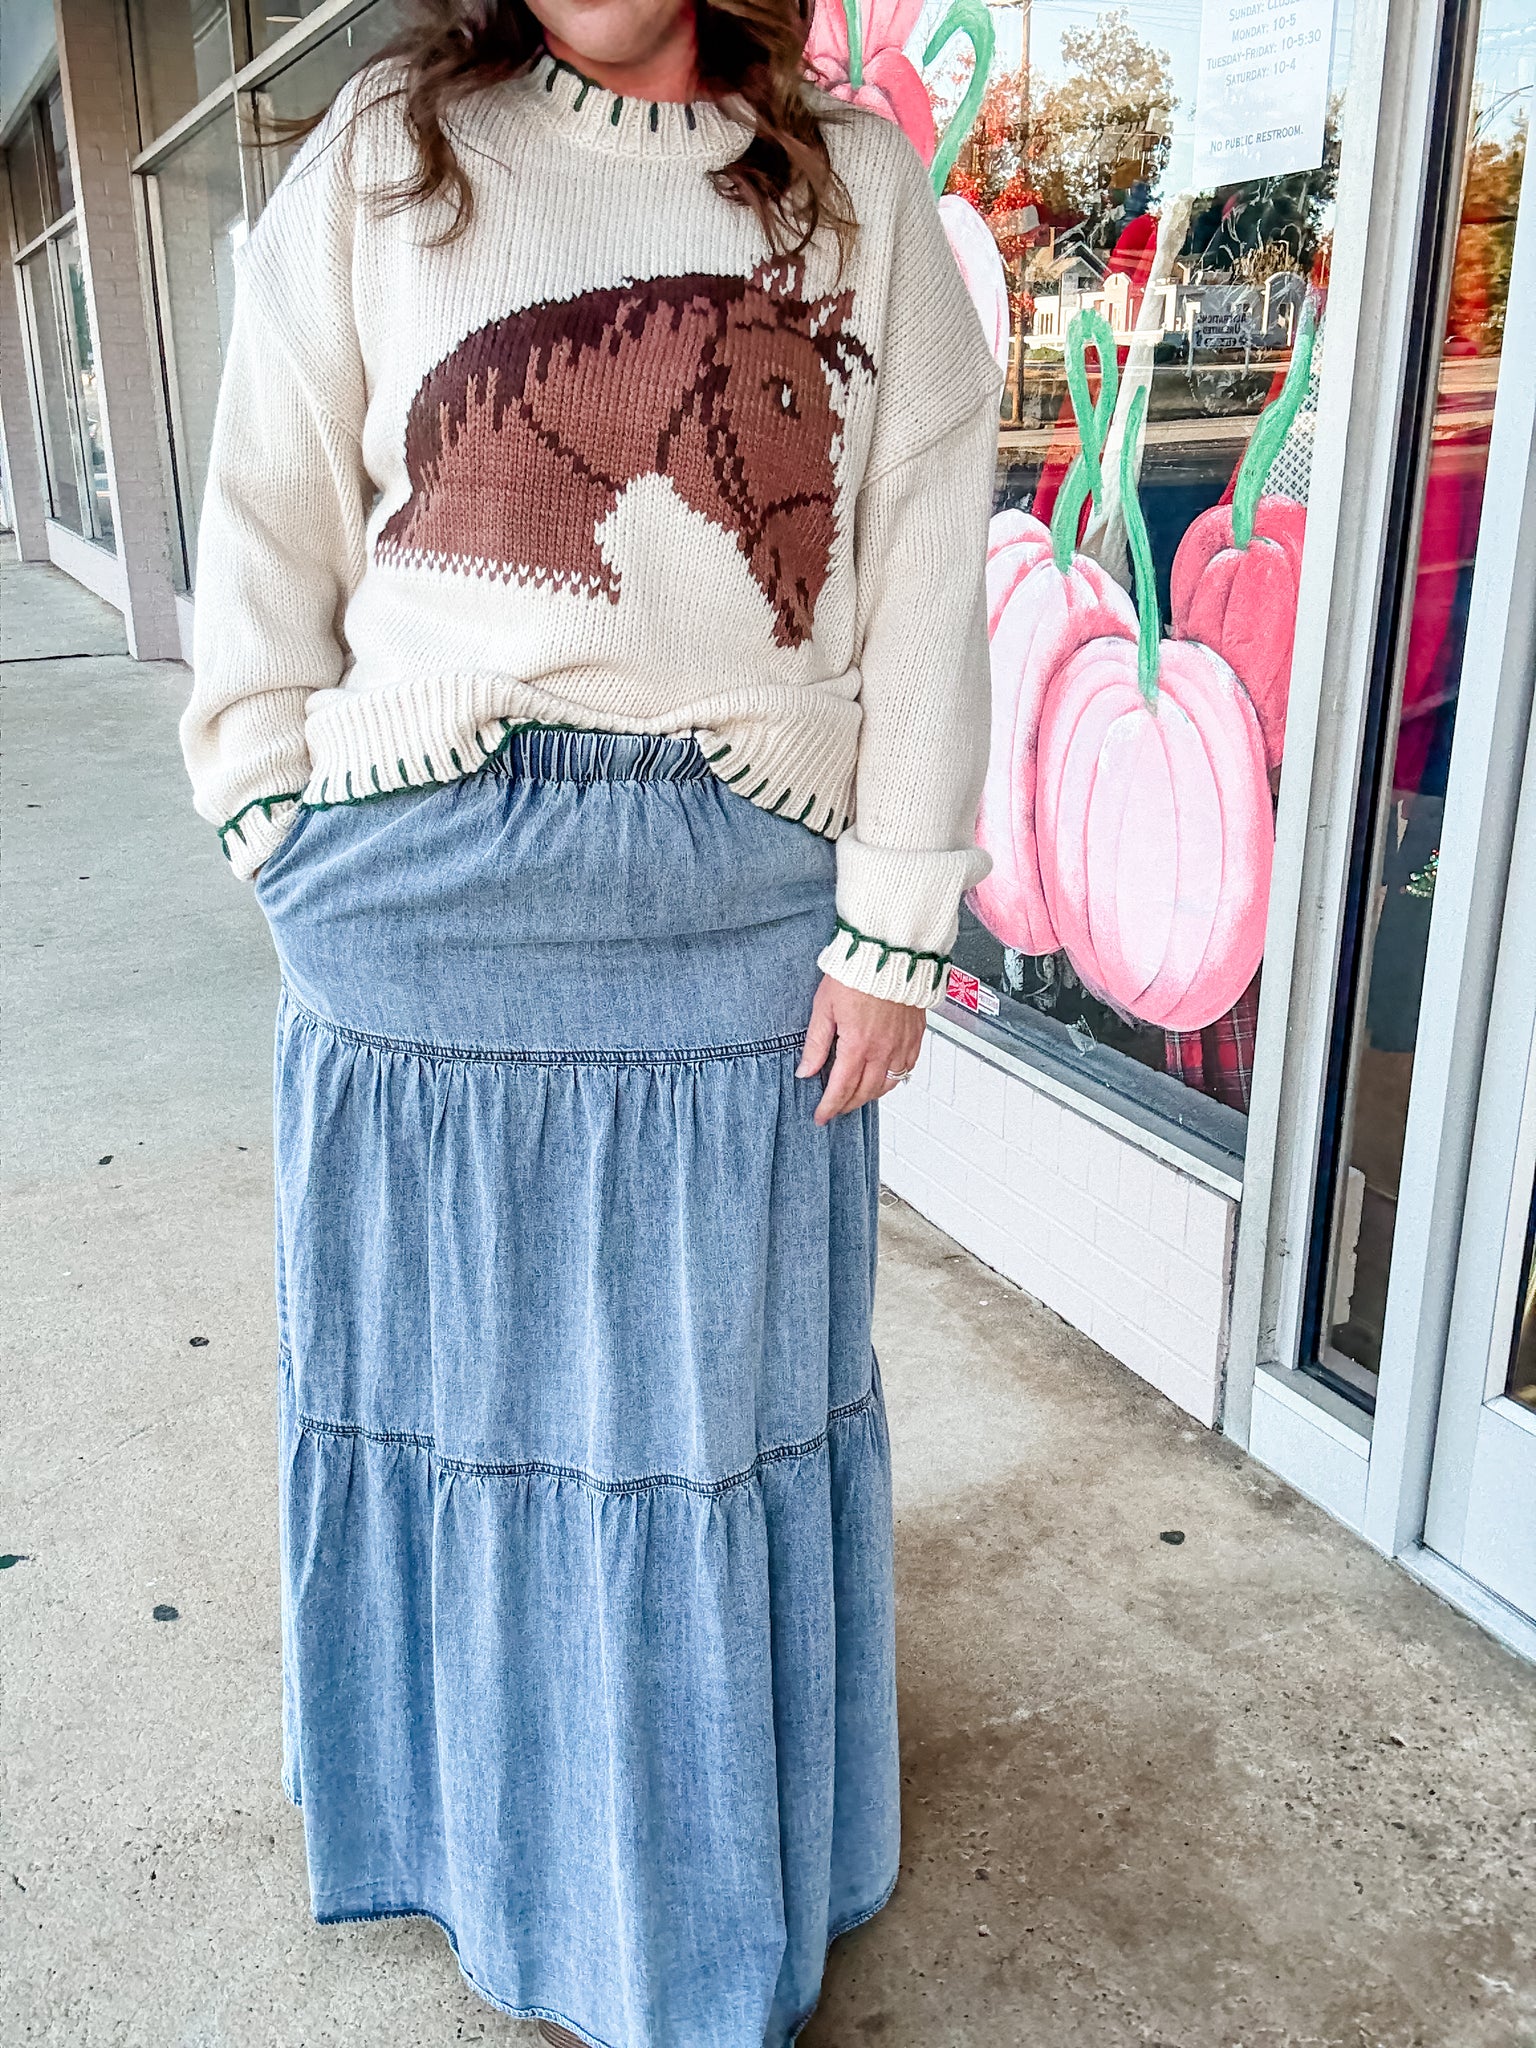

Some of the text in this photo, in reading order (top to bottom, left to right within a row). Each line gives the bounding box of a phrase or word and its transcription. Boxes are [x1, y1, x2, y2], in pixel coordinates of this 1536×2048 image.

[1229, 0, 1301, 21] SUNDAY: CLOS
[1232, 13, 1297, 43] MONDAY: 10-5
[1207, 29, 1321, 70] TUESDAY-FRIDAY: 10-5:30
[1226, 58, 1296, 87] SATURDAY: 10-4
[1210, 125, 1303, 153] NO PUBLIC RESTROOM.
